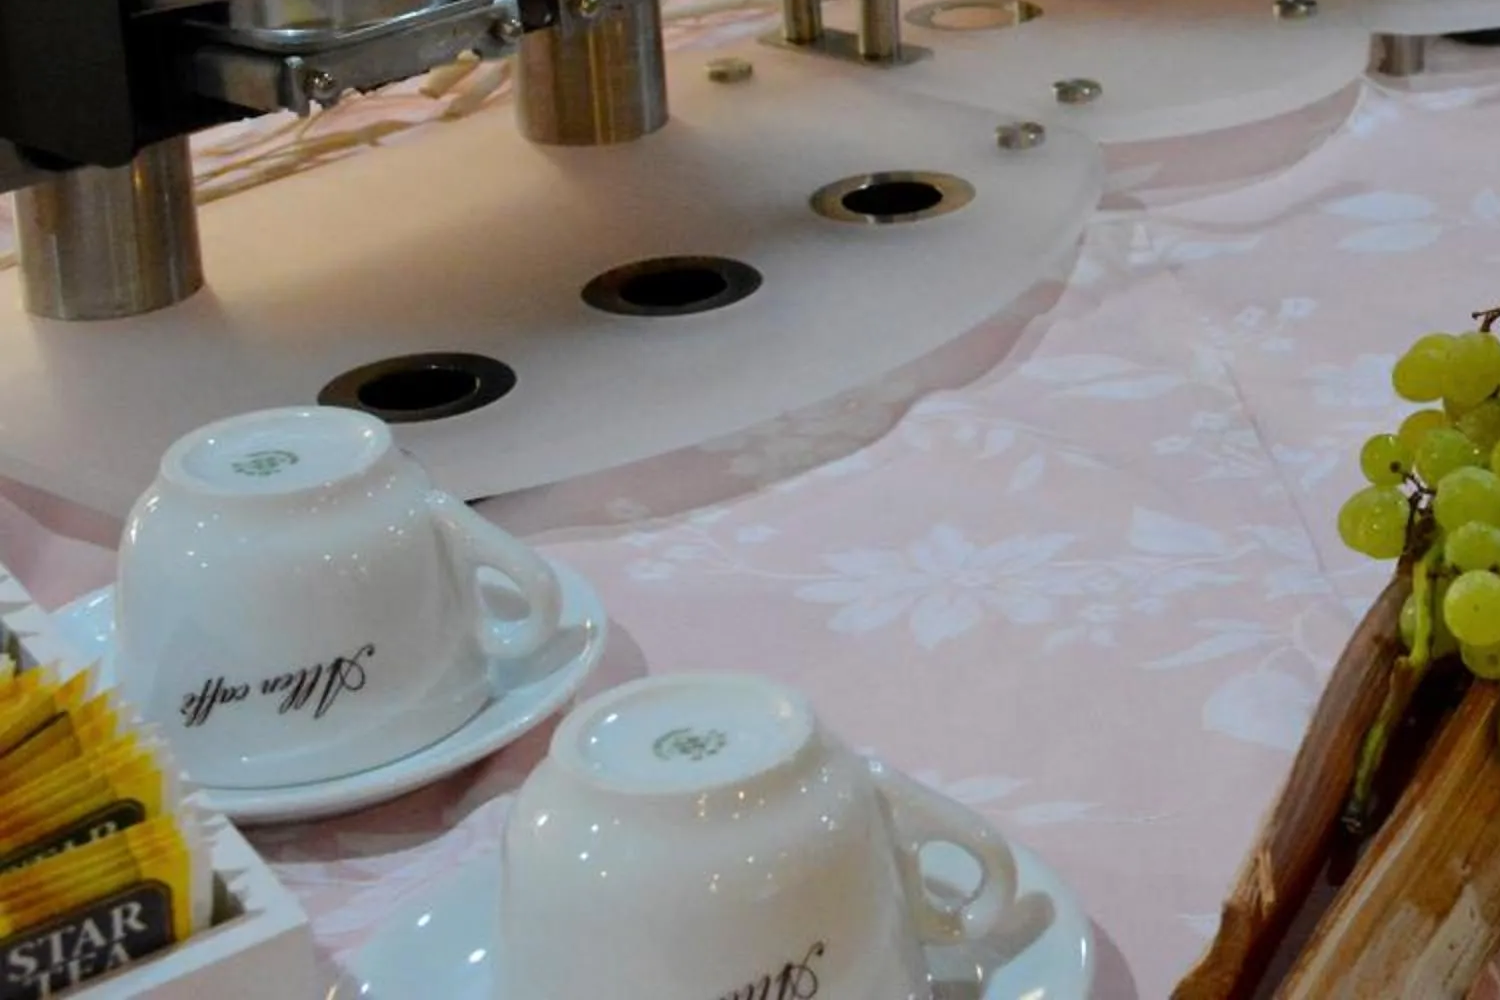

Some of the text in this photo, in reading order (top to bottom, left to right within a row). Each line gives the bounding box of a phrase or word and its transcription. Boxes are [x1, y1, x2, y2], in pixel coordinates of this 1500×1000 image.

[260, 643, 375, 720] Allen
[7, 901, 148, 987] STAR
[33, 942, 130, 997] TEA
